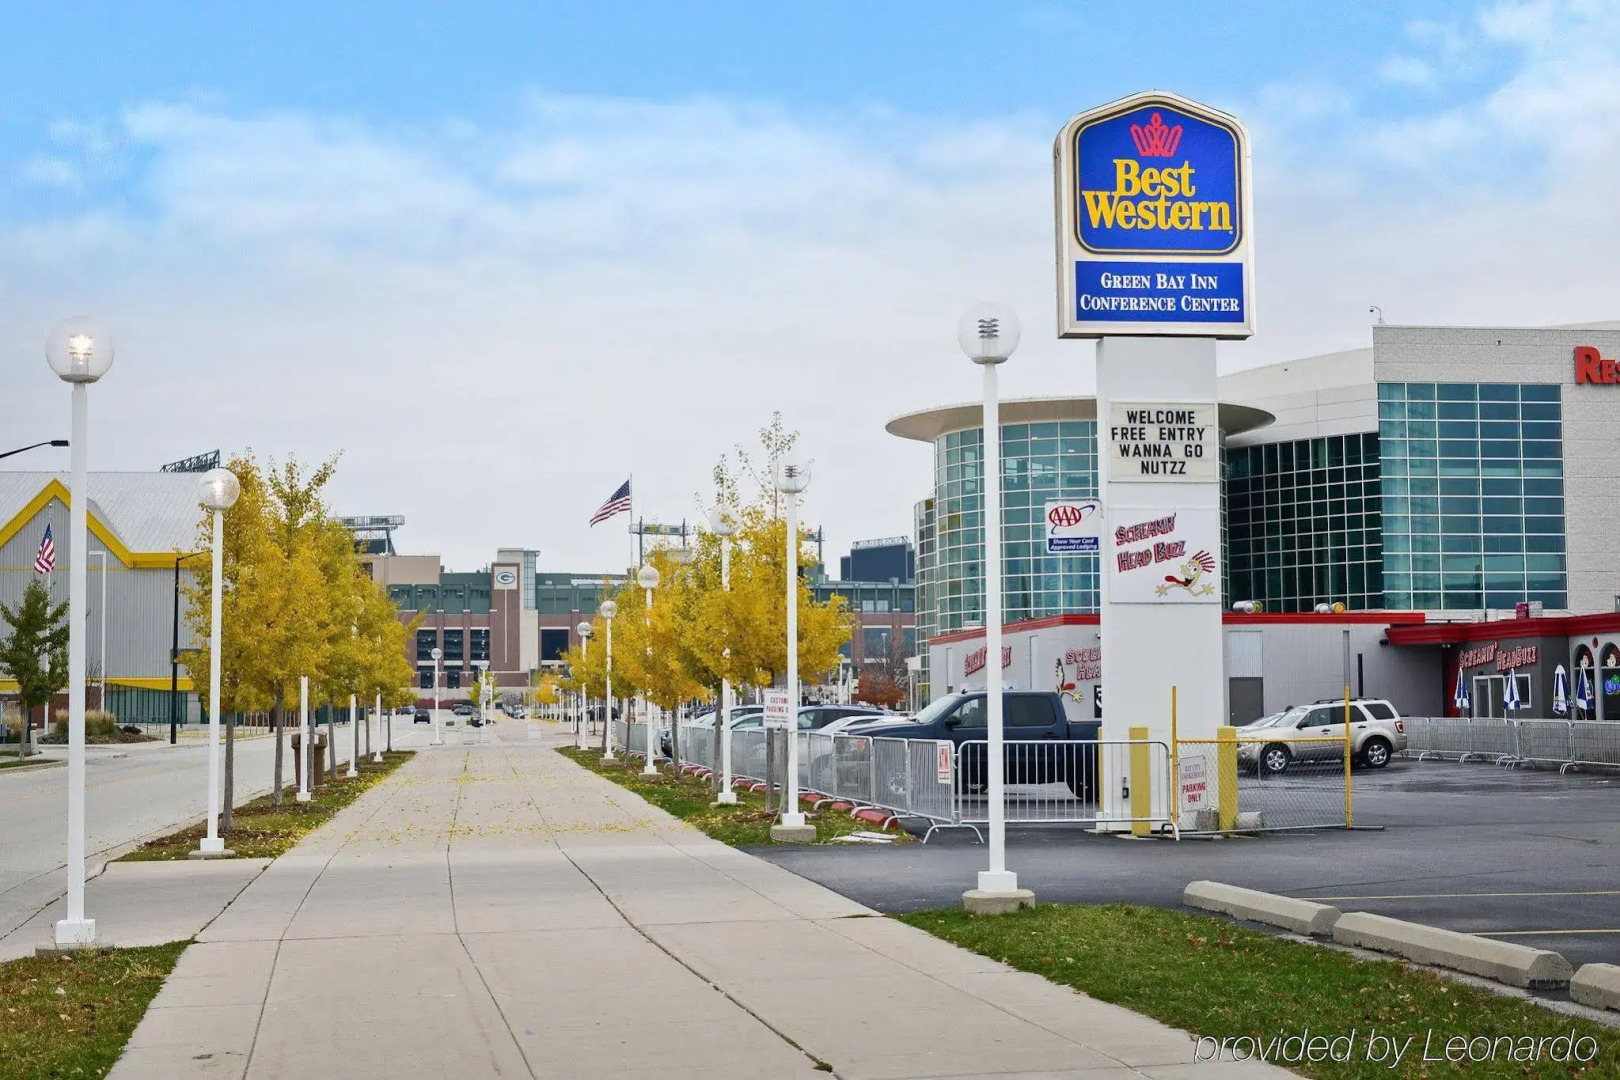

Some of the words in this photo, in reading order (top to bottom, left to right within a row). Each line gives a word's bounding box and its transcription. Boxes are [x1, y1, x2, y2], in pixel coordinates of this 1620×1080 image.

[1113, 159, 1195, 197] Best
[1082, 191, 1233, 230] Western
[1101, 272, 1150, 289] GREEN
[1156, 273, 1186, 289] BAY
[1190, 273, 1217, 289] INN
[1080, 294, 1176, 311] CONFERENCE
[1181, 295, 1239, 311] CENTER
[1127, 410, 1195, 424] WELCOME
[1111, 427, 1146, 440] FREE
[1159, 427, 1205, 441] ENTRY
[1119, 443, 1172, 457] WANNA
[1184, 444, 1203, 457] GO
[1141, 460, 1186, 474] NUTZZ
[1053, 506, 1078, 526] AAA
[1117, 548, 1152, 573] HEAD
[1153, 540, 1186, 563] BUZZ
[1182, 782, 1206, 793] PARKING
[1188, 793, 1201, 803] ONLY
